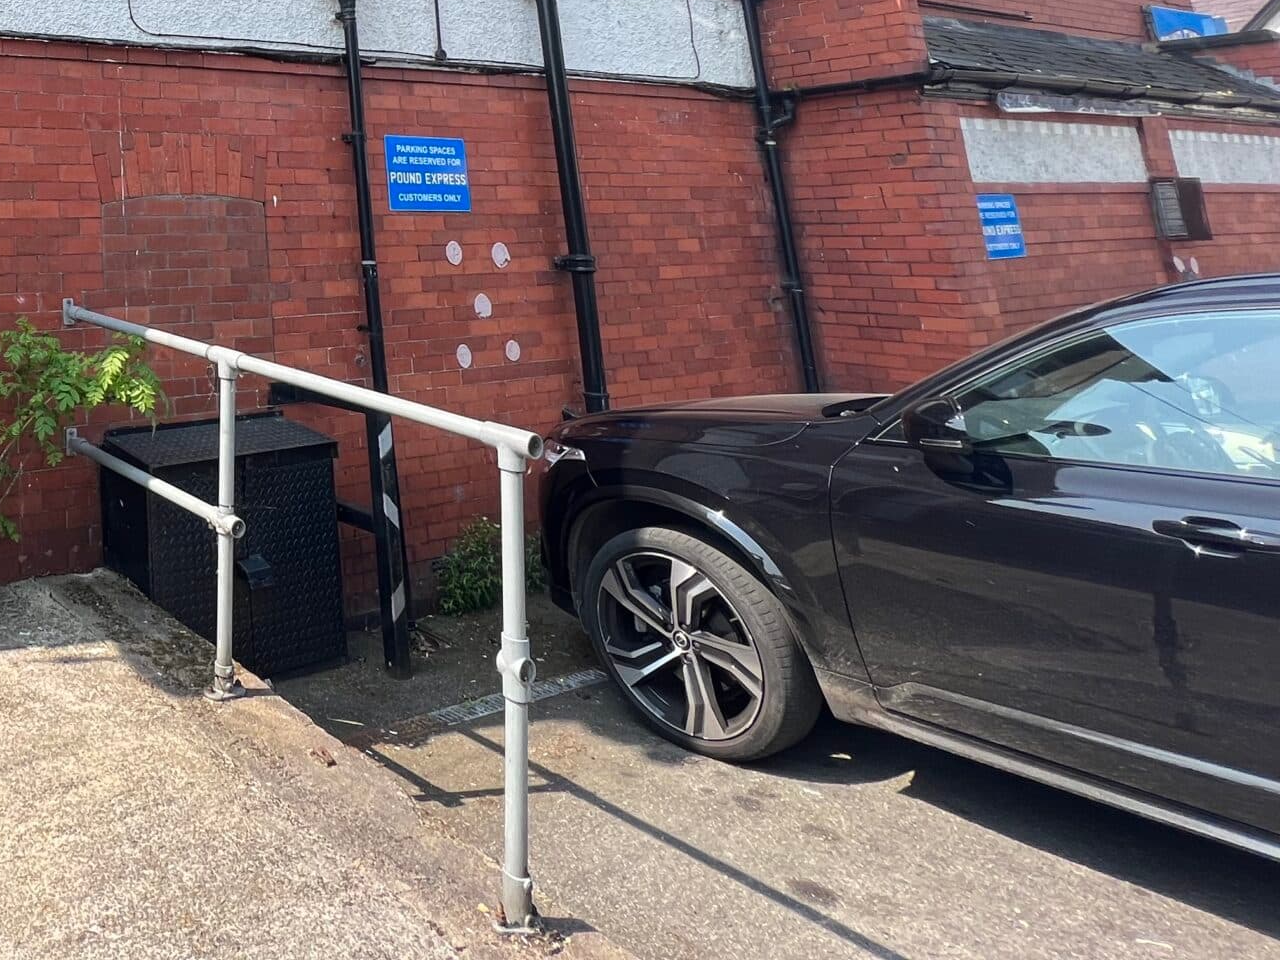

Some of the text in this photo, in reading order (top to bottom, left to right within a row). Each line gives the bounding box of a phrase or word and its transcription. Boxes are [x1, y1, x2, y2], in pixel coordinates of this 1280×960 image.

[396, 144, 456, 155] PARKING SPACES
[392, 156, 461, 166] ARE RESERVED FOR
[390, 171, 467, 186] POUND EXPRESS
[398, 193, 462, 202] CUSTOMERS ONLY
